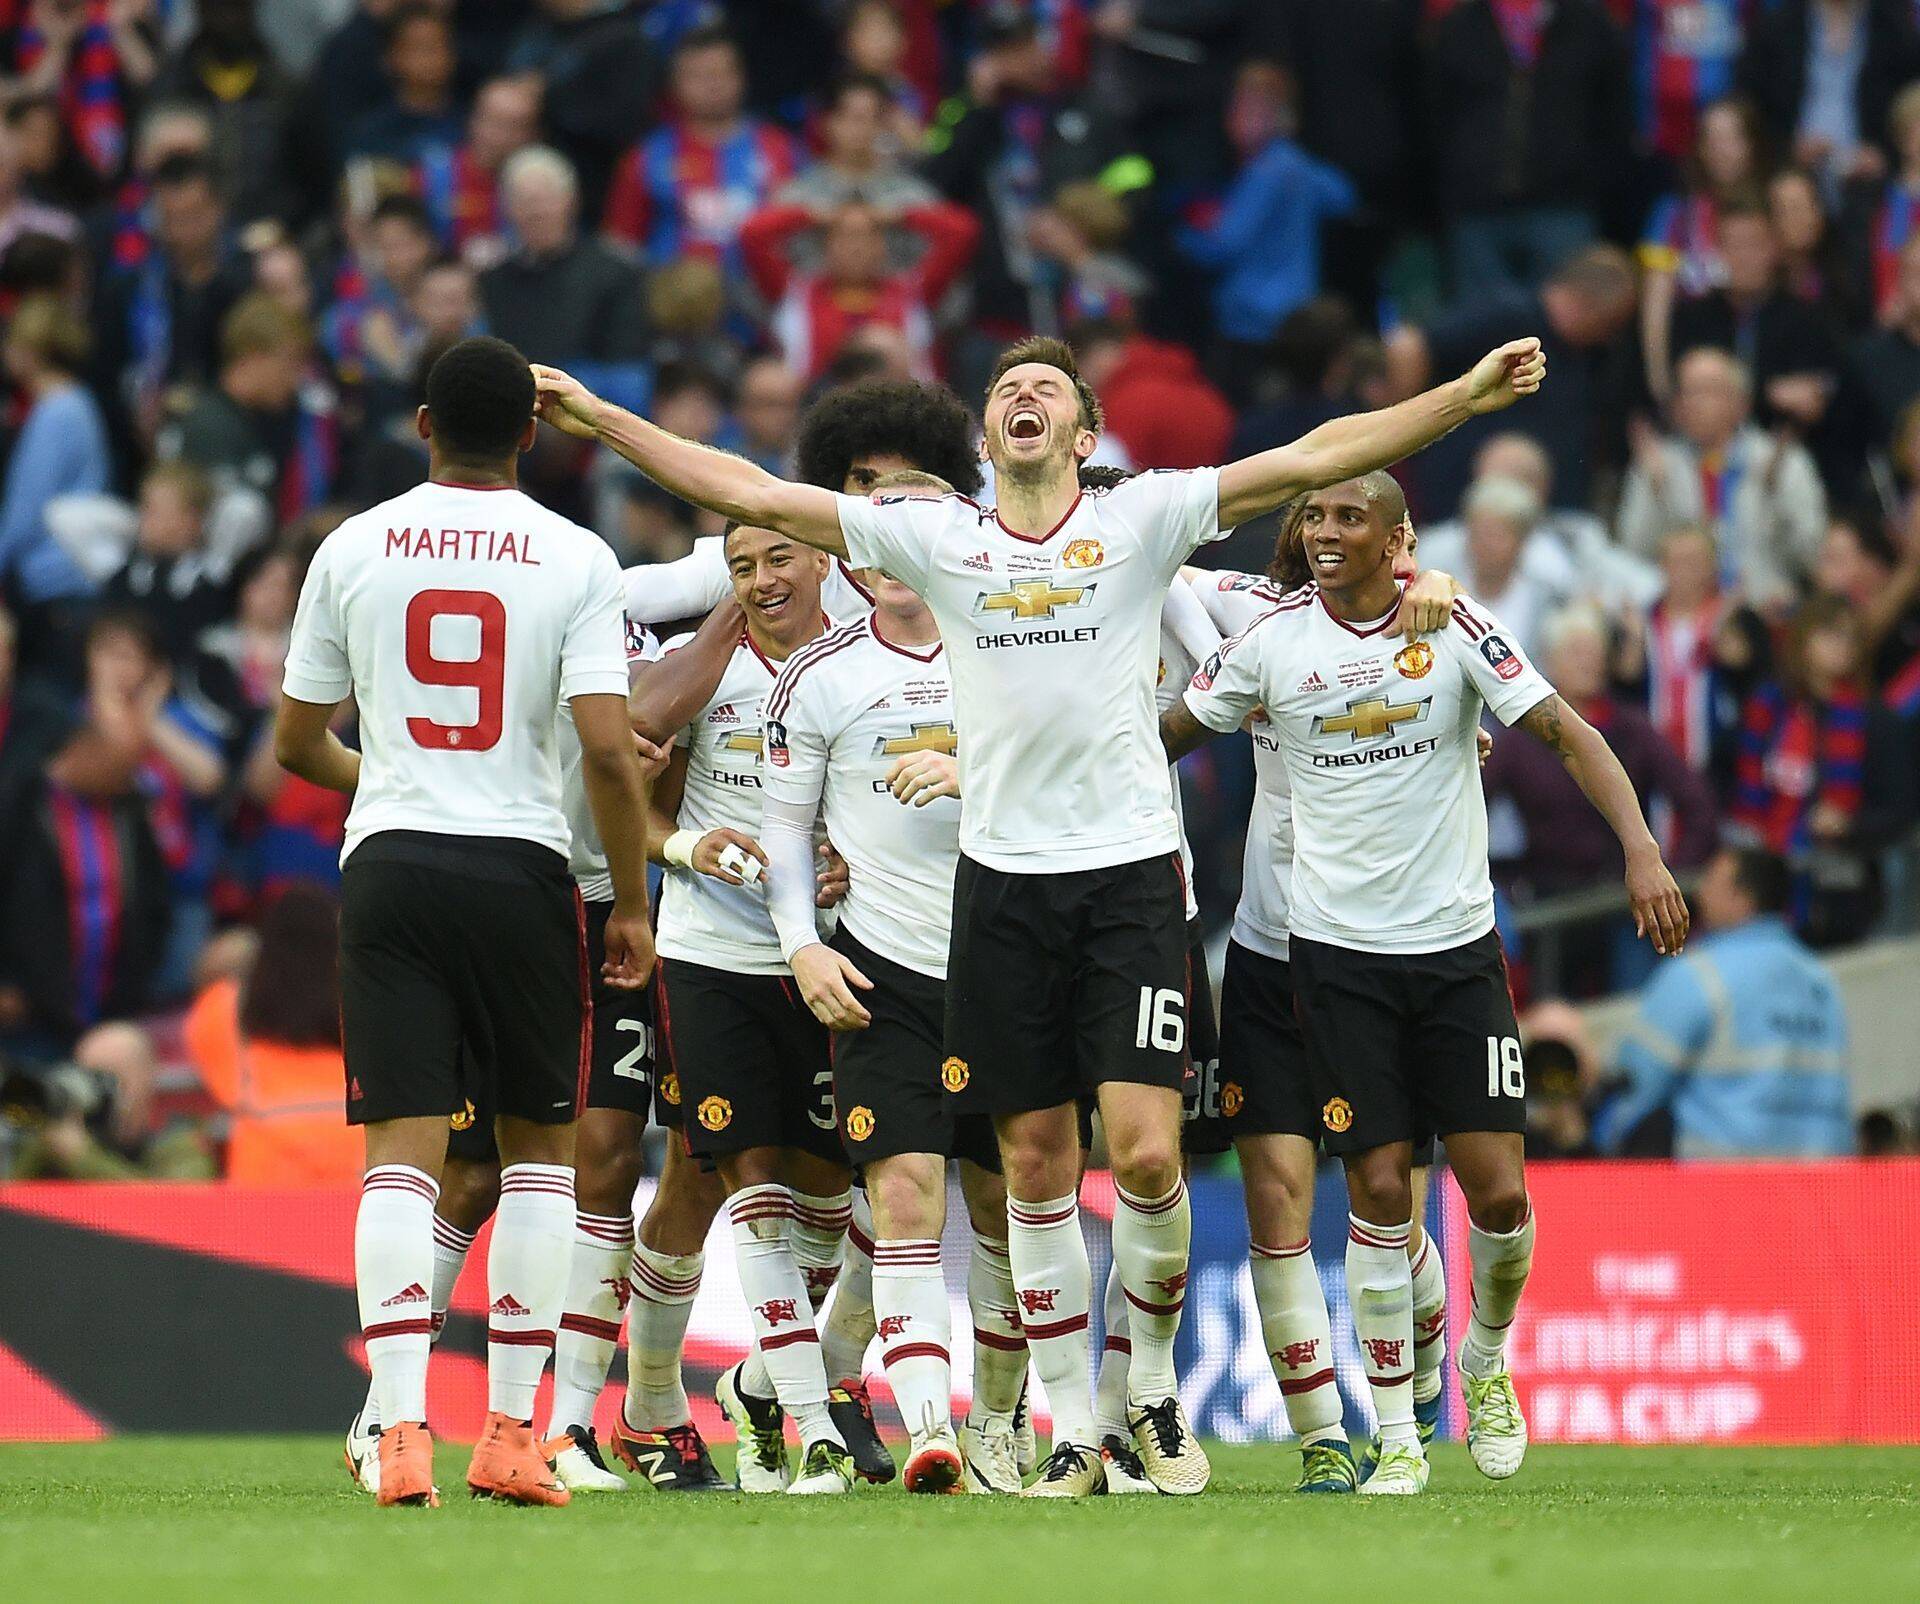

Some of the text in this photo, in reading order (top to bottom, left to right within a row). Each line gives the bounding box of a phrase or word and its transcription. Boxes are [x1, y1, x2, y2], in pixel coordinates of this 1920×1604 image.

[385, 528, 540, 565] MARTIAL
[962, 559, 993, 572] adidas
[976, 627, 1101, 649] CHEVROLET
[406, 588, 506, 752] 9
[1297, 683, 1328, 692] adidas
[708, 715, 740, 723] adidas
[1312, 737, 1439, 768] CHEVROLET
[1136, 986, 1184, 1053] 16
[1487, 1036, 1525, 1098] 18
